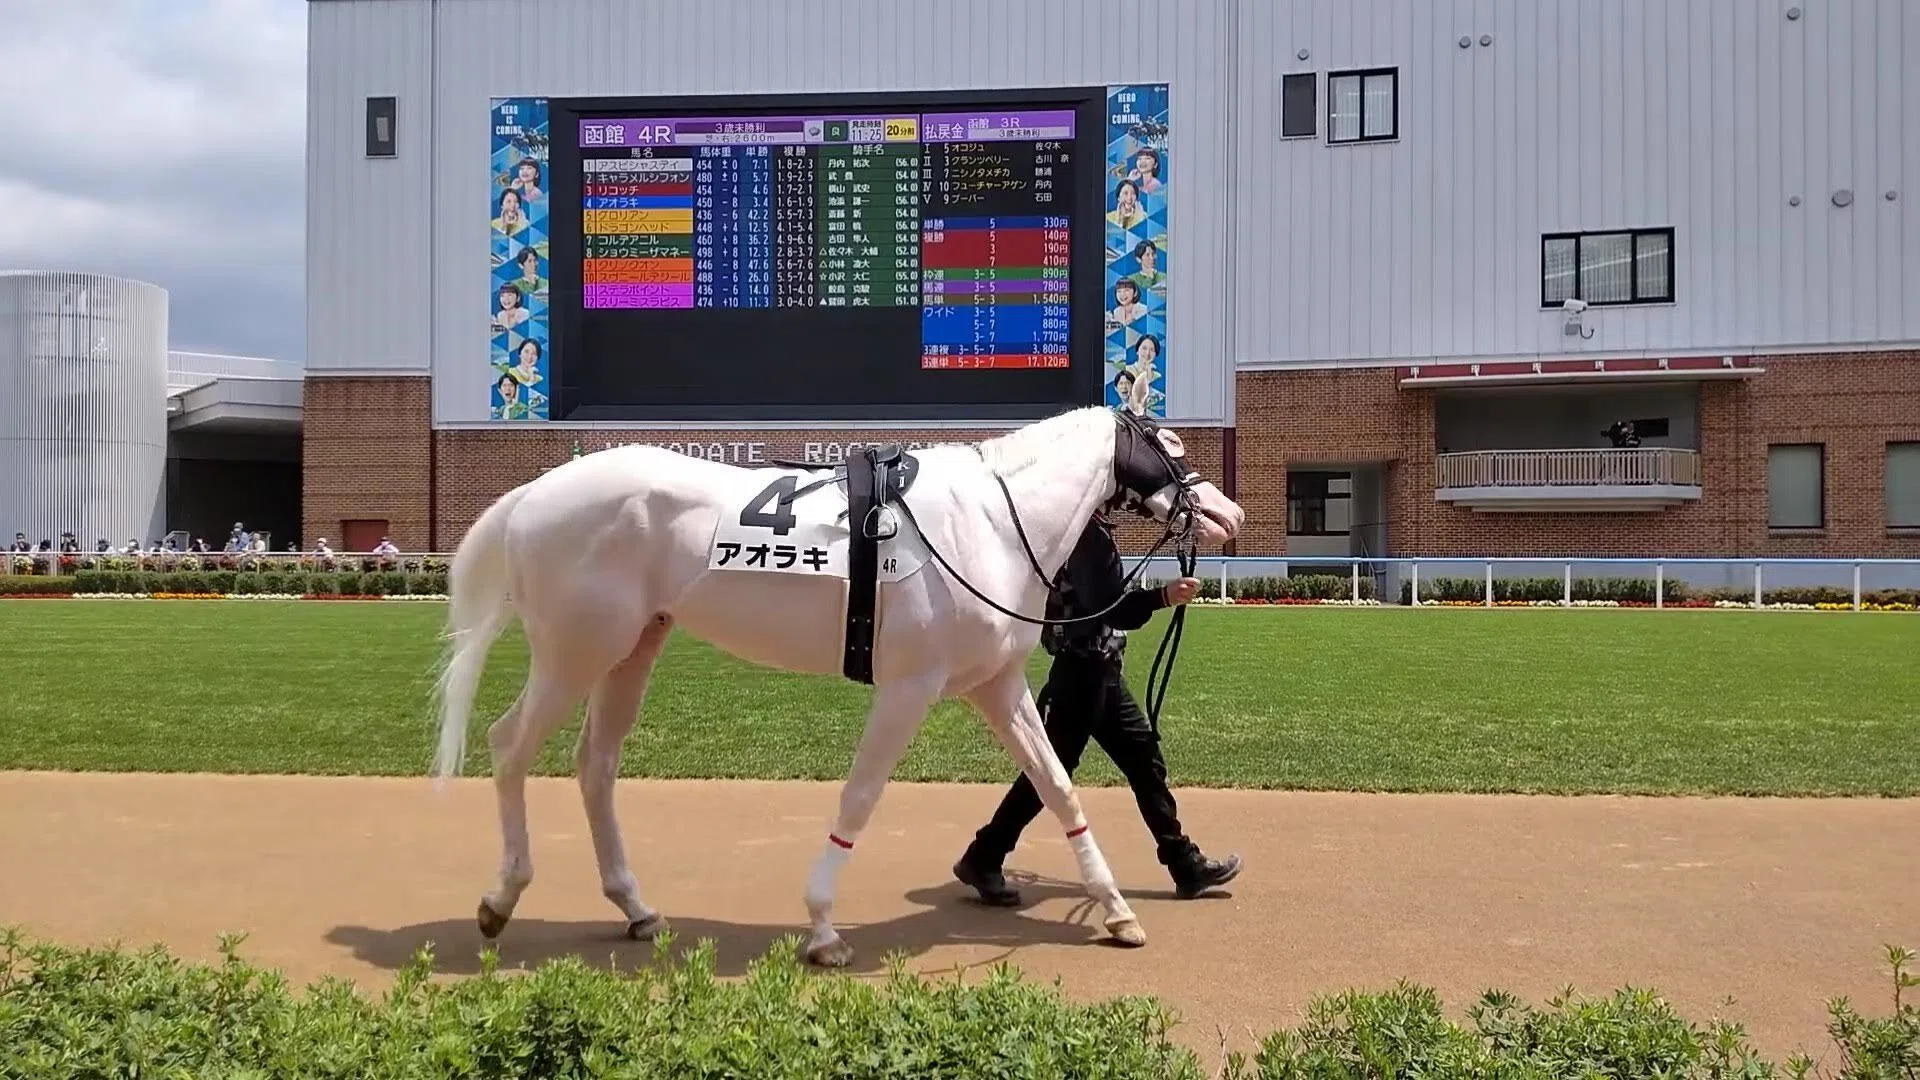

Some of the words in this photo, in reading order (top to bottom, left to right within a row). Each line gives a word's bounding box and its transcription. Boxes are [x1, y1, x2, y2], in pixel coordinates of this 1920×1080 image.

[1118, 93, 1136, 103] HERO
[501, 105, 518, 115] HERO
[1123, 104, 1131, 113] IS
[506, 116, 513, 124] IS
[1001, 117, 1020, 128] 3R
[1112, 114, 1140, 124] COMING
[496, 125, 522, 135] COMING
[584, 125, 624, 145] 函館
[639, 125, 672, 144] 4R
[852, 129, 882, 141] 11:25
[925, 123, 964, 140] 払戻金
[631, 147, 653, 158] 馬名
[700, 146, 732, 157] 馬体重
[746, 146, 768, 156] 単勝
[784, 146, 806, 156] 複勝
[853, 144, 885, 155] 騎手名
[944, 144, 950, 153] 5
[1035, 142, 1061, 151] 佐々木
[586, 161, 592, 171] 1
[697, 160, 712, 170] 454
[753, 160, 769, 169] 7.1
[828, 158, 846, 168] 丹内
[944, 157, 950, 166] 3
[1035, 154, 1053, 164] 古川
[586, 174, 592, 183] 2
[598, 173, 691, 183] キャラメルシフォン
[697, 173, 712, 183] 480
[753, 172, 769, 182] 5.7
[944, 169, 950, 179] 7
[952, 168, 1011, 178] ニシノタメチカ
[586, 186, 592, 196] 3
[598, 186, 639, 196] リコッチ
[697, 185, 712, 195] 454
[753, 185, 769, 194] 4.6
[939, 182, 950, 192] 10
[952, 181, 1027, 190] フューチャーアゲン
[1035, 180, 1052, 189] 丹内
[586, 198, 592, 208] 4
[598, 198, 639, 208] アオラキ
[697, 198, 712, 208] 450
[753, 198, 769, 207] 3.4
[944, 195, 950, 204] 9
[1035, 193, 1052, 202] 石田
[586, 211, 592, 221] 5
[697, 210, 712, 220] 436
[748, 210, 769, 219] 42.2
[586, 223, 592, 232] 6
[697, 223, 713, 232] 448
[748, 223, 769, 232] 12.5
[924, 220, 944, 230] 単勝
[990, 218, 996, 228] 5
[1043, 218, 1068, 228] 330円
[586, 236, 592, 246] 7
[697, 236, 713, 245] 460
[748, 235, 769, 245] 36.2
[990, 232, 996, 242] 5
[1044, 231, 1068, 241] 140円
[586, 248, 592, 258] 8
[598, 248, 690, 258] ショウミーザマネー
[697, 248, 713, 258] 498
[748, 248, 769, 257] 12.3
[828, 247, 853, 257] 佐々木
[990, 244, 996, 254] 3
[1043, 244, 1068, 253] 190円
[697, 261, 713, 270] 446
[748, 260, 769, 270] 47.6
[828, 260, 846, 269] 小林
[990, 257, 996, 266] 7
[1043, 256, 1068, 266] 410円
[585, 273, 594, 282] 10
[697, 273, 713, 282] 488
[748, 273, 769, 282] 26.0
[828, 272, 846, 281] 小沢
[1043, 269, 1068, 278] 890円
[585, 286, 594, 295] 11
[697, 285, 713, 295] 436
[748, 285, 769, 294] 14.0
[1043, 282, 1068, 291] 780円
[585, 298, 594, 307] 12
[697, 298, 713, 307] 474
[748, 298, 769, 307] 11.3
[924, 308, 954, 317] ワイド
[1043, 307, 1068, 316] 360円
[1043, 319, 1068, 329] 880円
[740, 475, 798, 536] 4
[716, 542, 829, 572] アオラキ
[882, 558, 897, 574] 4R
